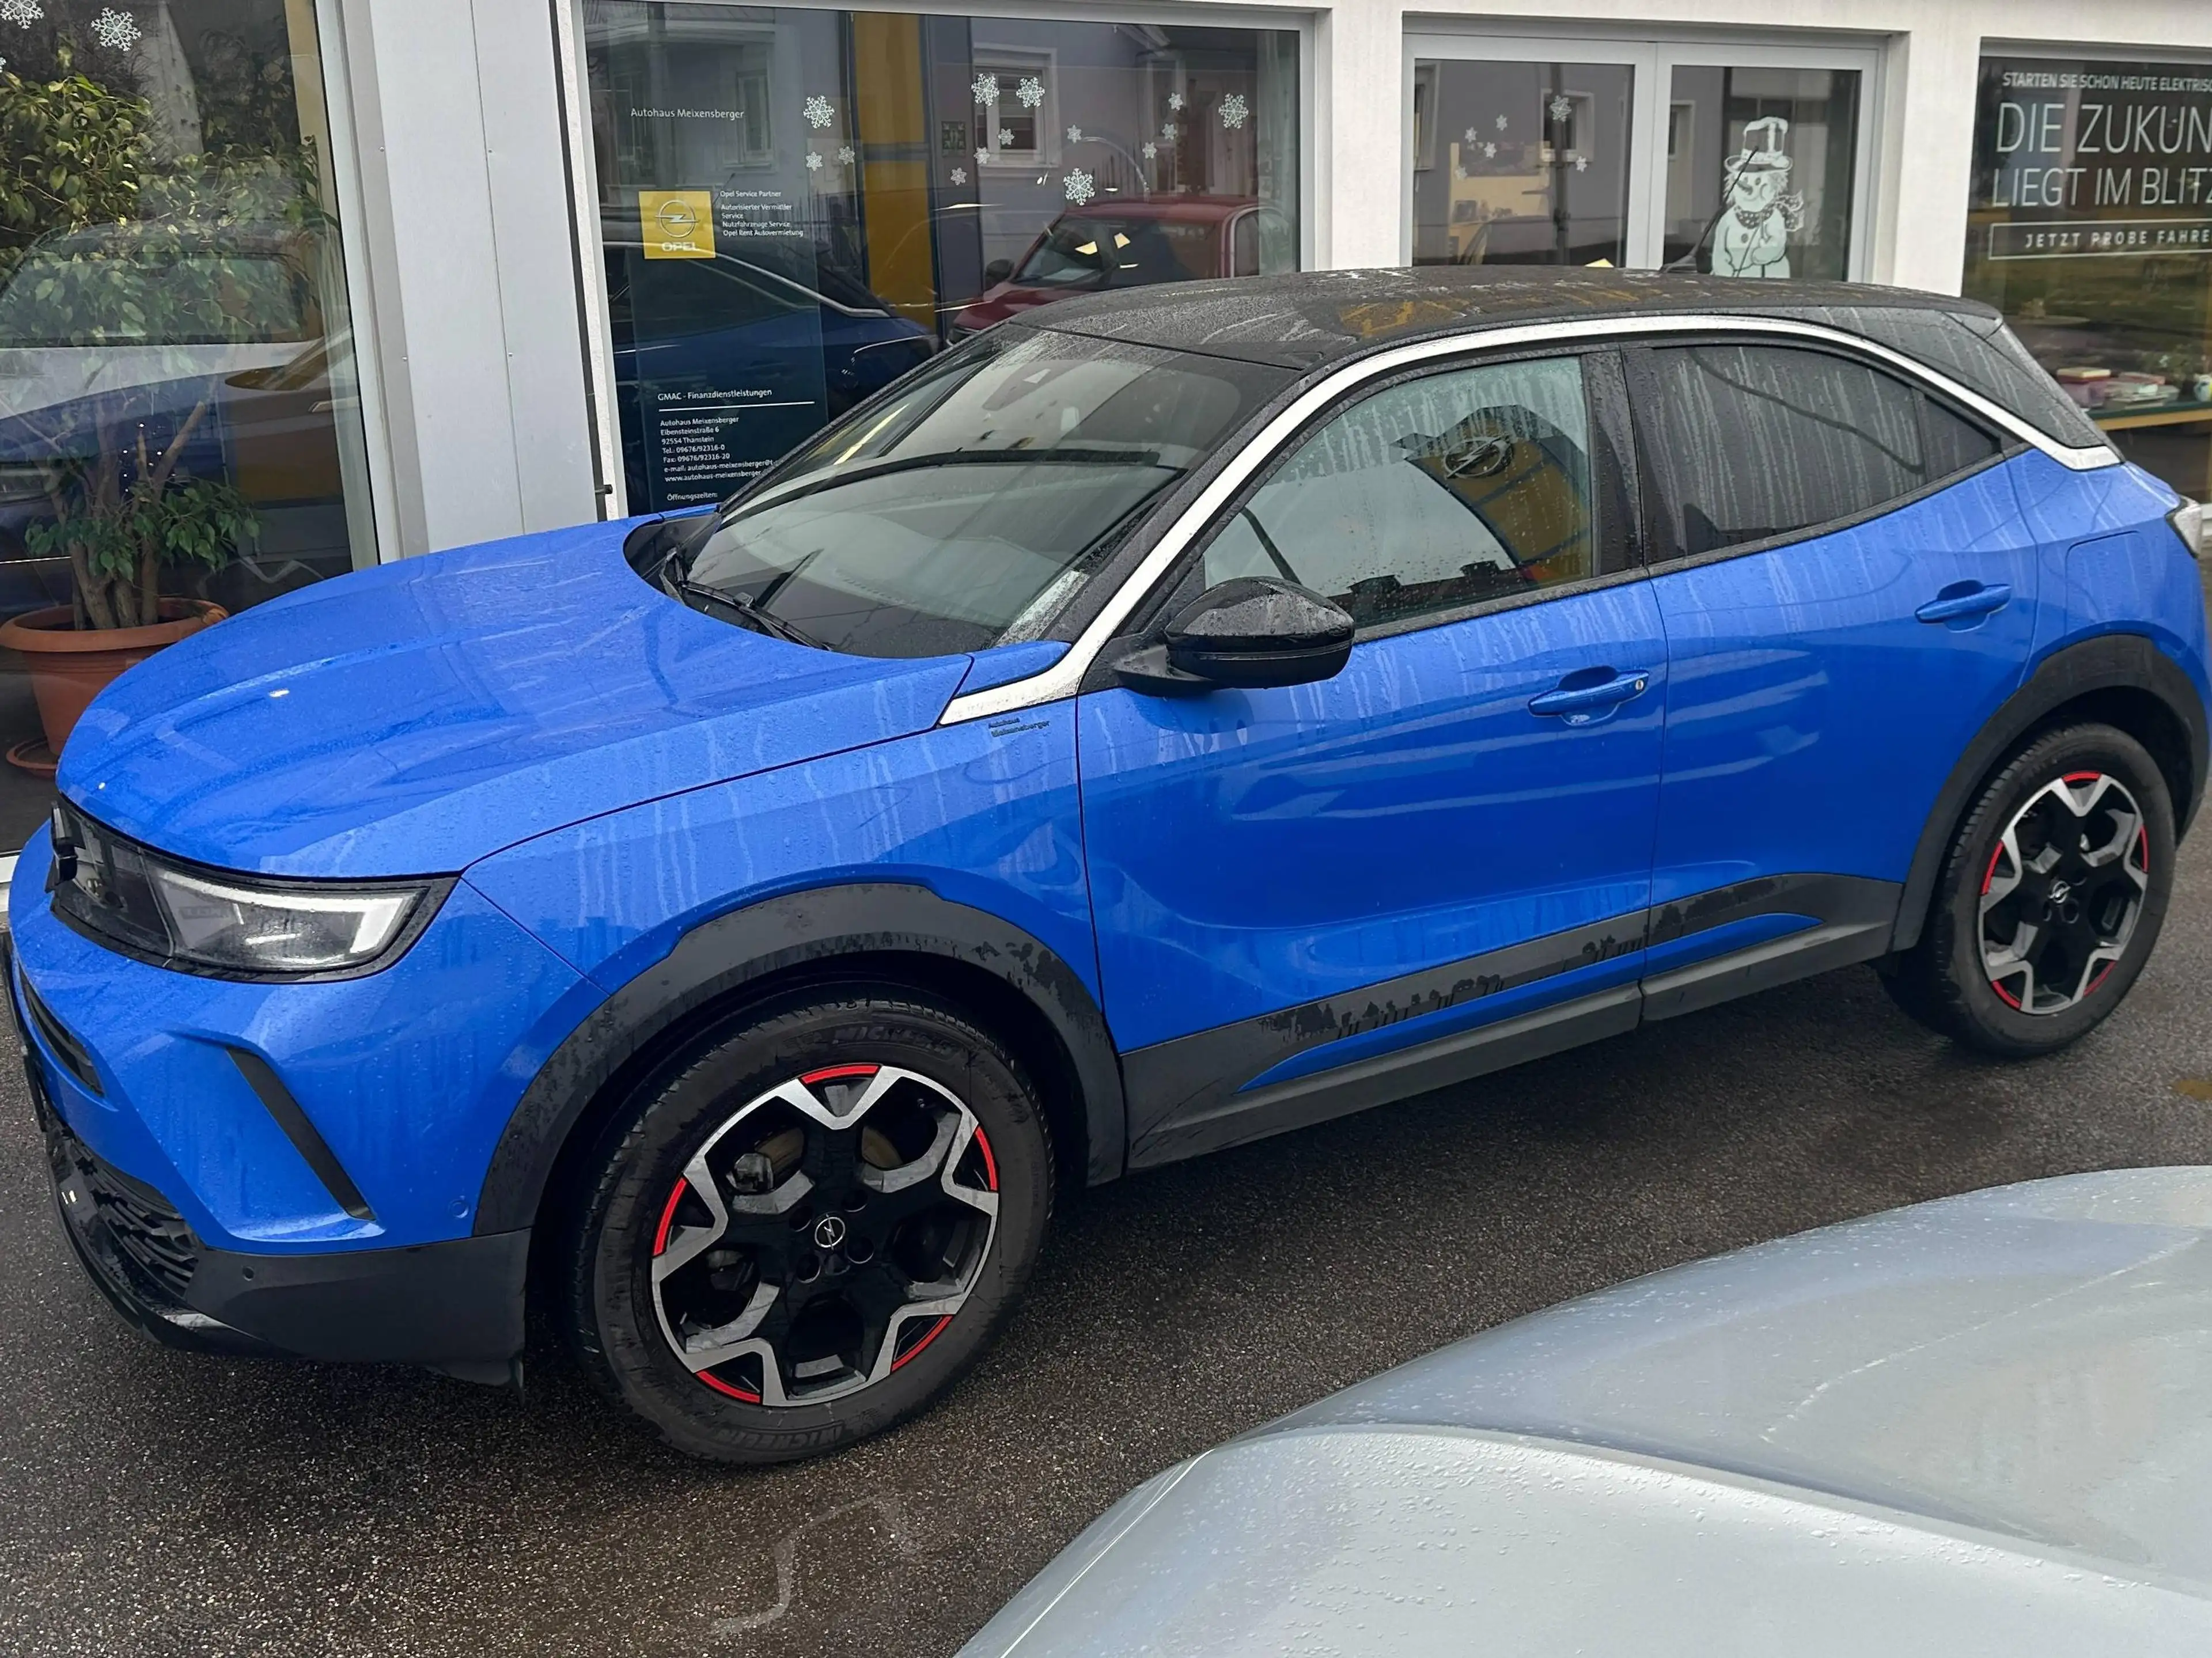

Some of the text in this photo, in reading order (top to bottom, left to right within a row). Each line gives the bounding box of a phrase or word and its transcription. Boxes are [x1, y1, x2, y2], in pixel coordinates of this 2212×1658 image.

[2002, 72, 2057, 88] STARTEN
[2059, 74, 2078, 89] SIE
[2080, 74, 2119, 90] SCHON
[2121, 75, 2158, 90] HEUTE
[631, 108, 745, 121] Autohaus Meixensberger
[1997, 103, 2212, 154] DIE ZUKUN
[1992, 168, 2088, 207] LIEGT
[2095, 168, 2132, 206] IM
[2025, 229, 2212, 248] JETZT PROBE FAHRE
[661, 242, 696, 252] OPEL
[657, 392, 682, 401] GMAC
[687, 389, 772, 400] Finanzdienstleistungen
[692, 417, 740, 425] Meixensberger
[661, 436, 714, 445] 92554 Thanstein
